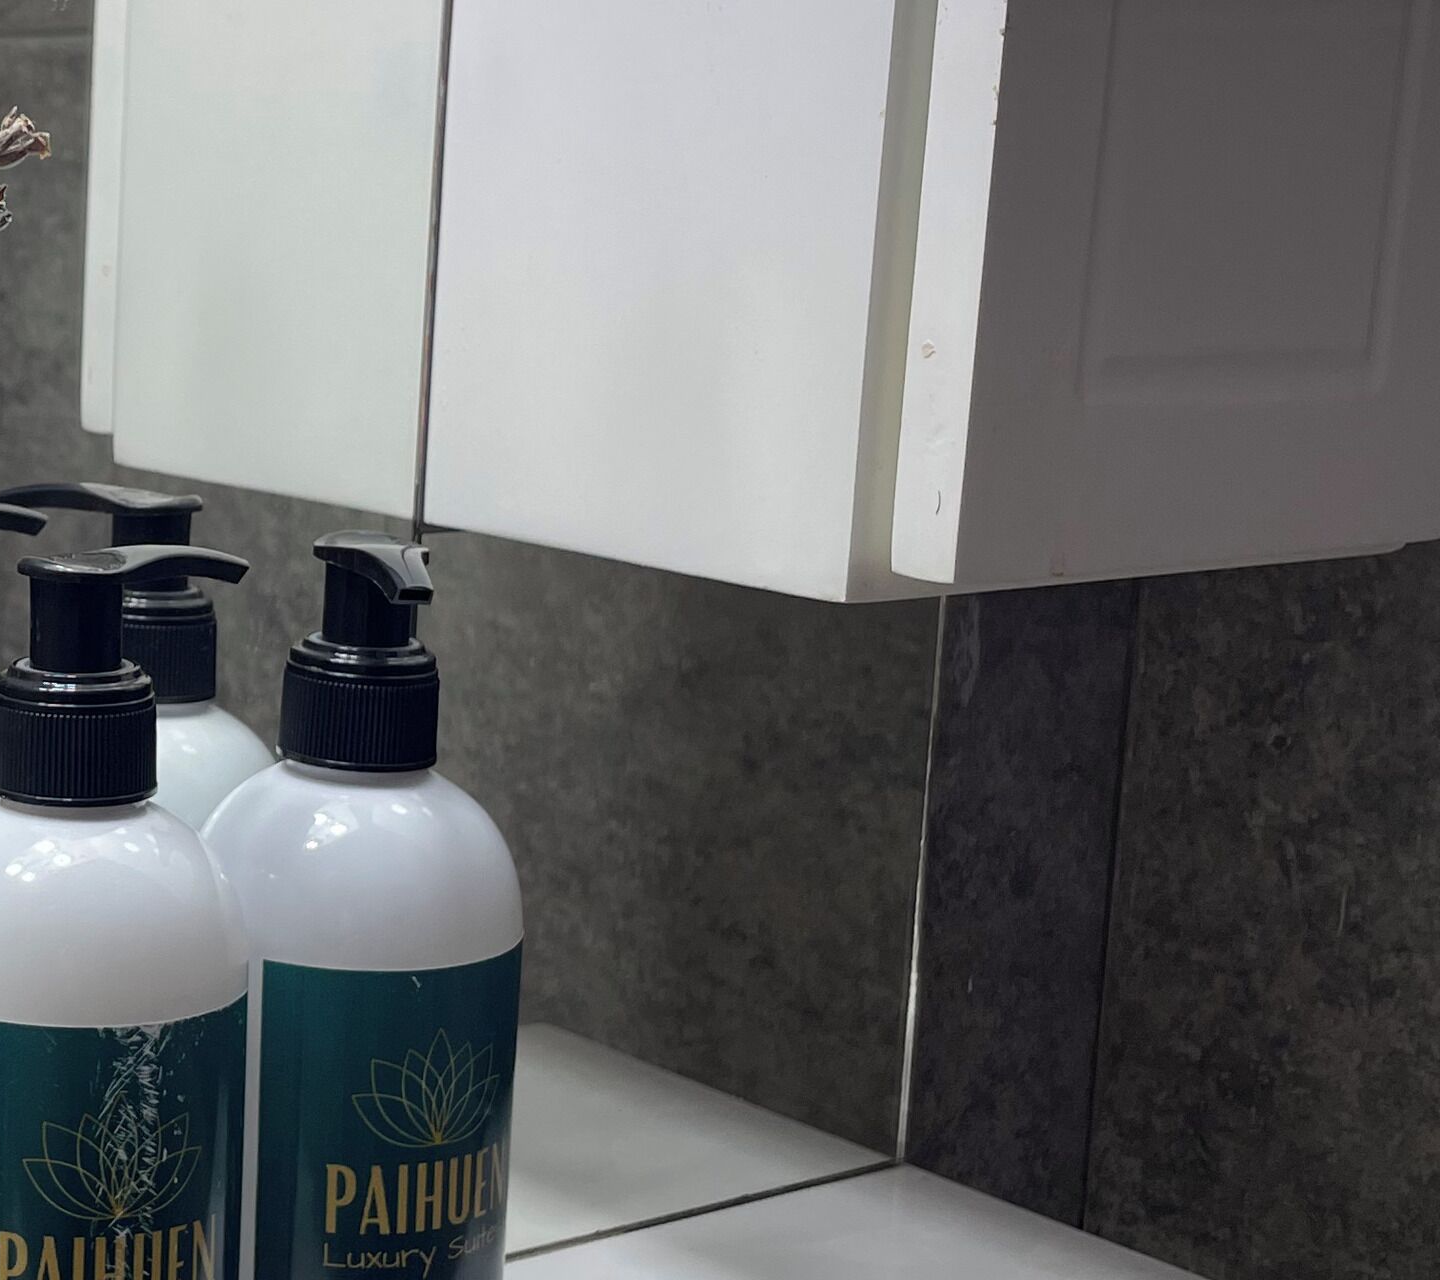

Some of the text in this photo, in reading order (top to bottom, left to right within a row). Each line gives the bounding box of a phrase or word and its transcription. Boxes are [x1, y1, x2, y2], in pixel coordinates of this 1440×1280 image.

[326, 1142, 505, 1234] PAIHUEN
[323, 1223, 501, 1280] Luxury Suite
